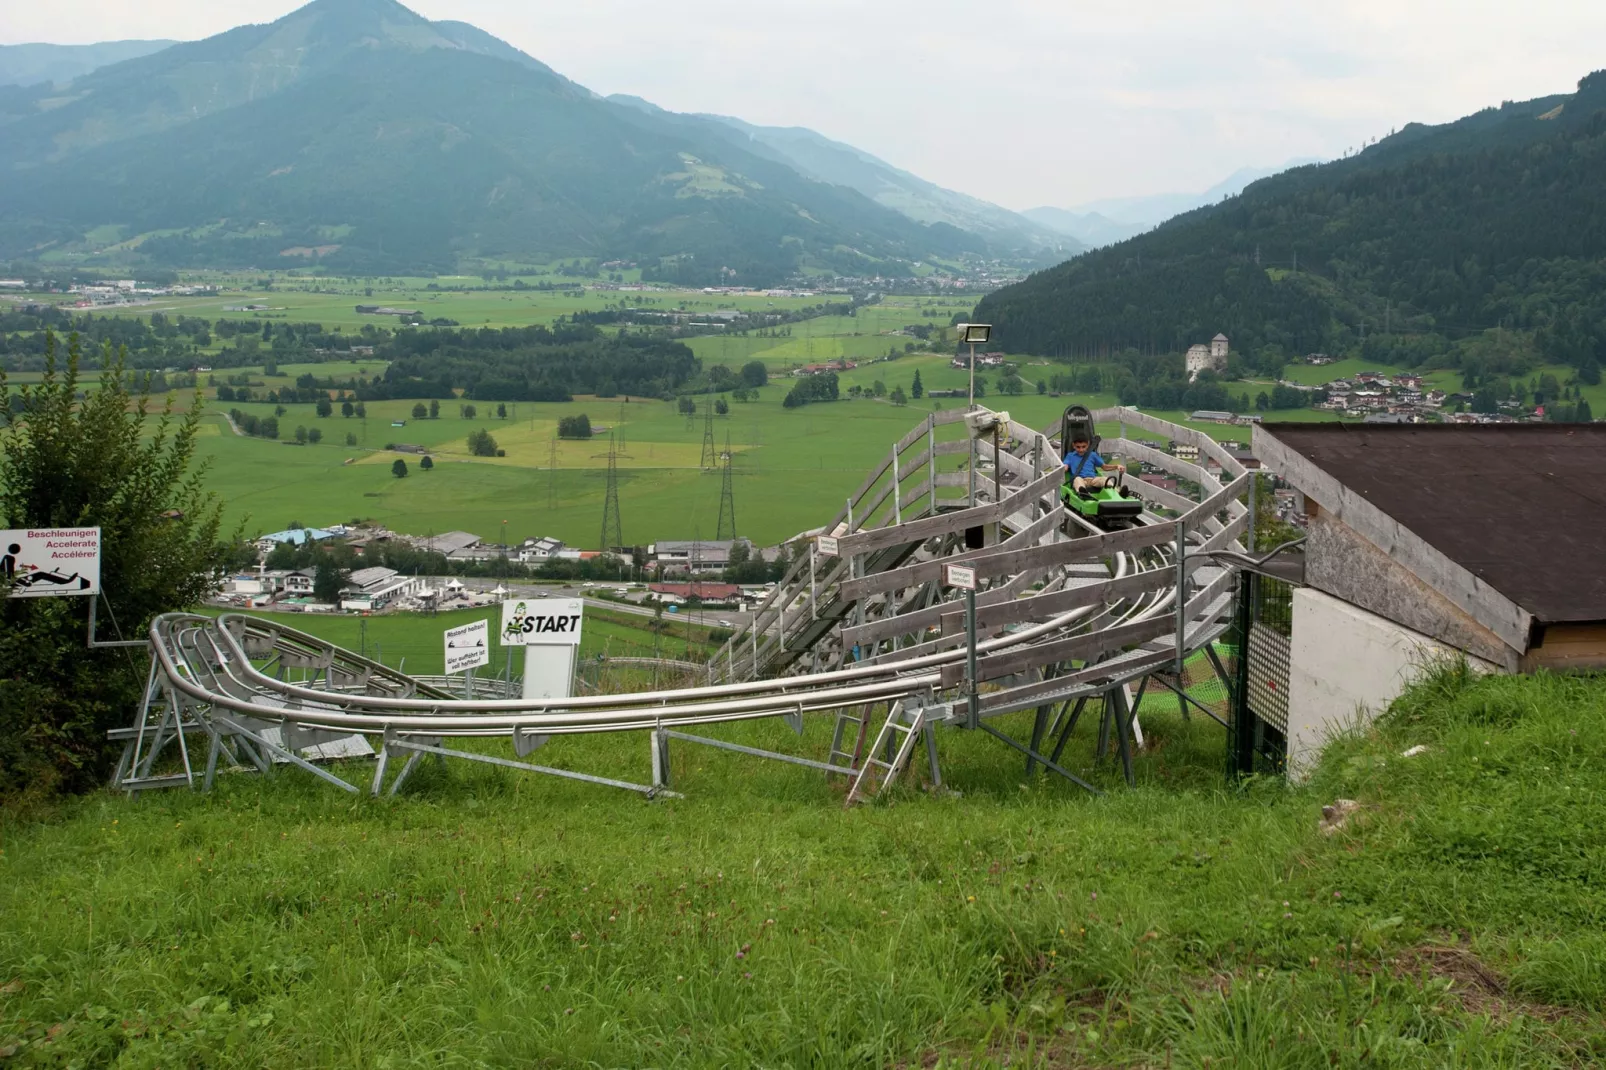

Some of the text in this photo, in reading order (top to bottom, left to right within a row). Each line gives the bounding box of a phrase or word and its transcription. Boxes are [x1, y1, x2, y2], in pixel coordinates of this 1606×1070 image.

[27, 530, 97, 538] Beschleunigen
[46, 540, 97, 548] Accelerate
[51, 551, 97, 559] Accélérer
[522, 615, 581, 633] START
[447, 628, 467, 637] Abstand
[452, 662, 460, 670] voll
